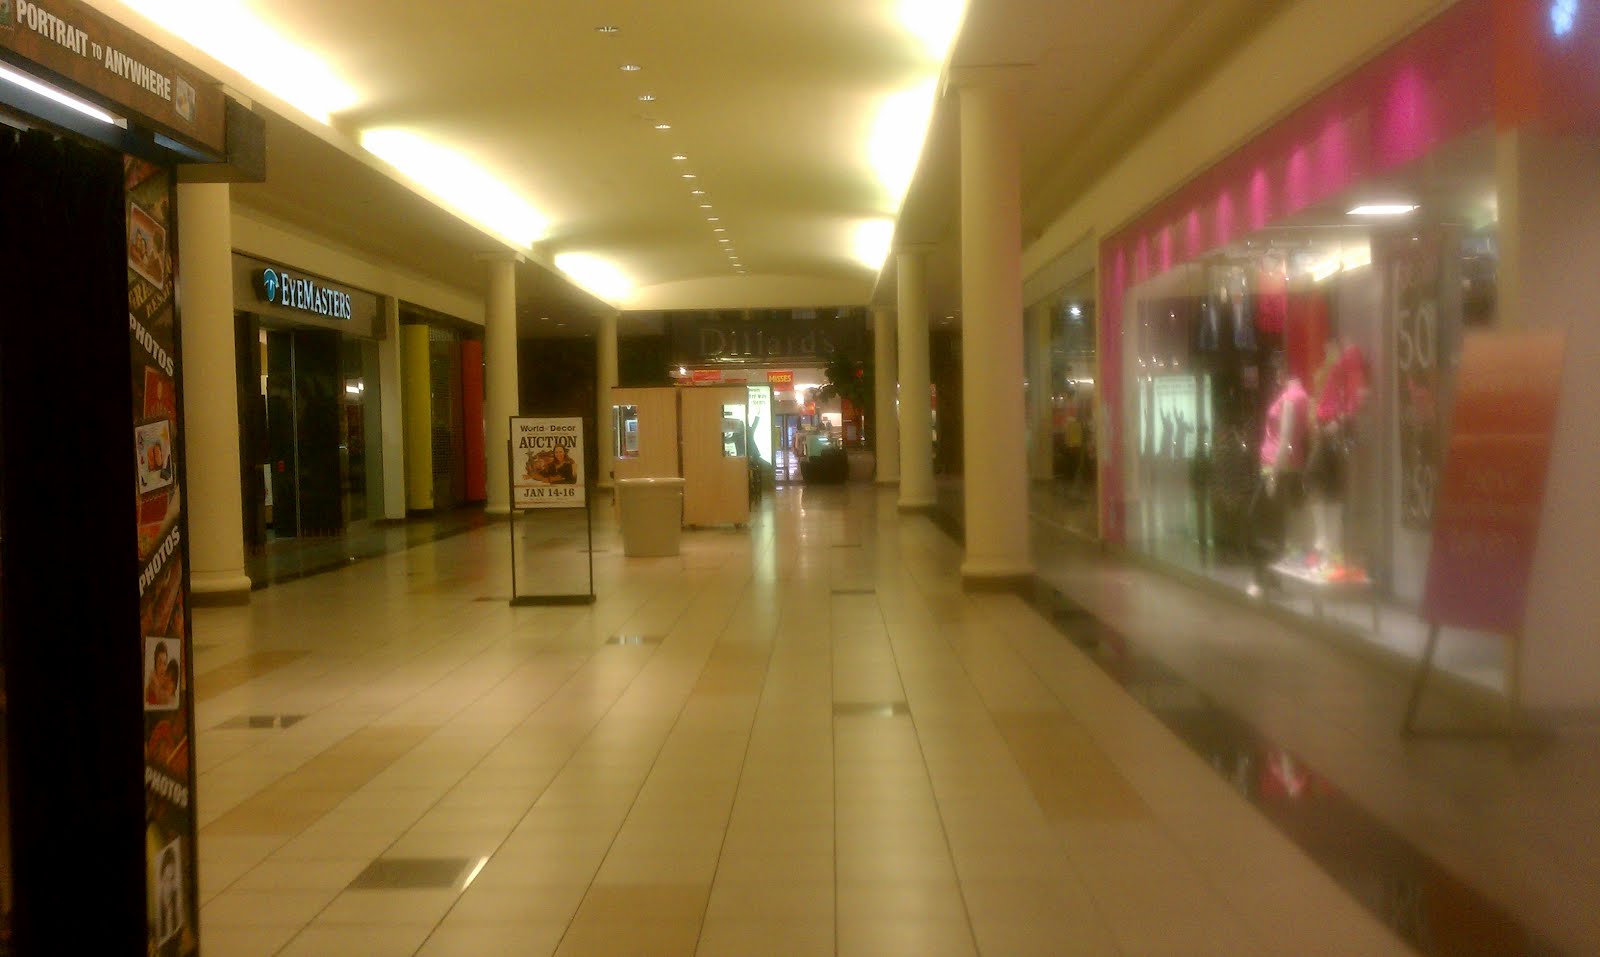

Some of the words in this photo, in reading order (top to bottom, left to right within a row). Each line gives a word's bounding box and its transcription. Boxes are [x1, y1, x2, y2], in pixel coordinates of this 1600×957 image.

[16, 0, 89, 58] PORTRAIT
[91, 41, 102, 61] TO
[104, 46, 171, 101] ANYWHERE
[129, 312, 174, 377] PHOTOS
[768, 374, 792, 383] MISSES
[519, 435, 577, 449] AUCTION
[524, 488, 545, 497] JAN
[548, 488, 575, 497] 14-16
[139, 525, 181, 597] PHOTOS
[145, 766, 188, 808] PHOTOS
